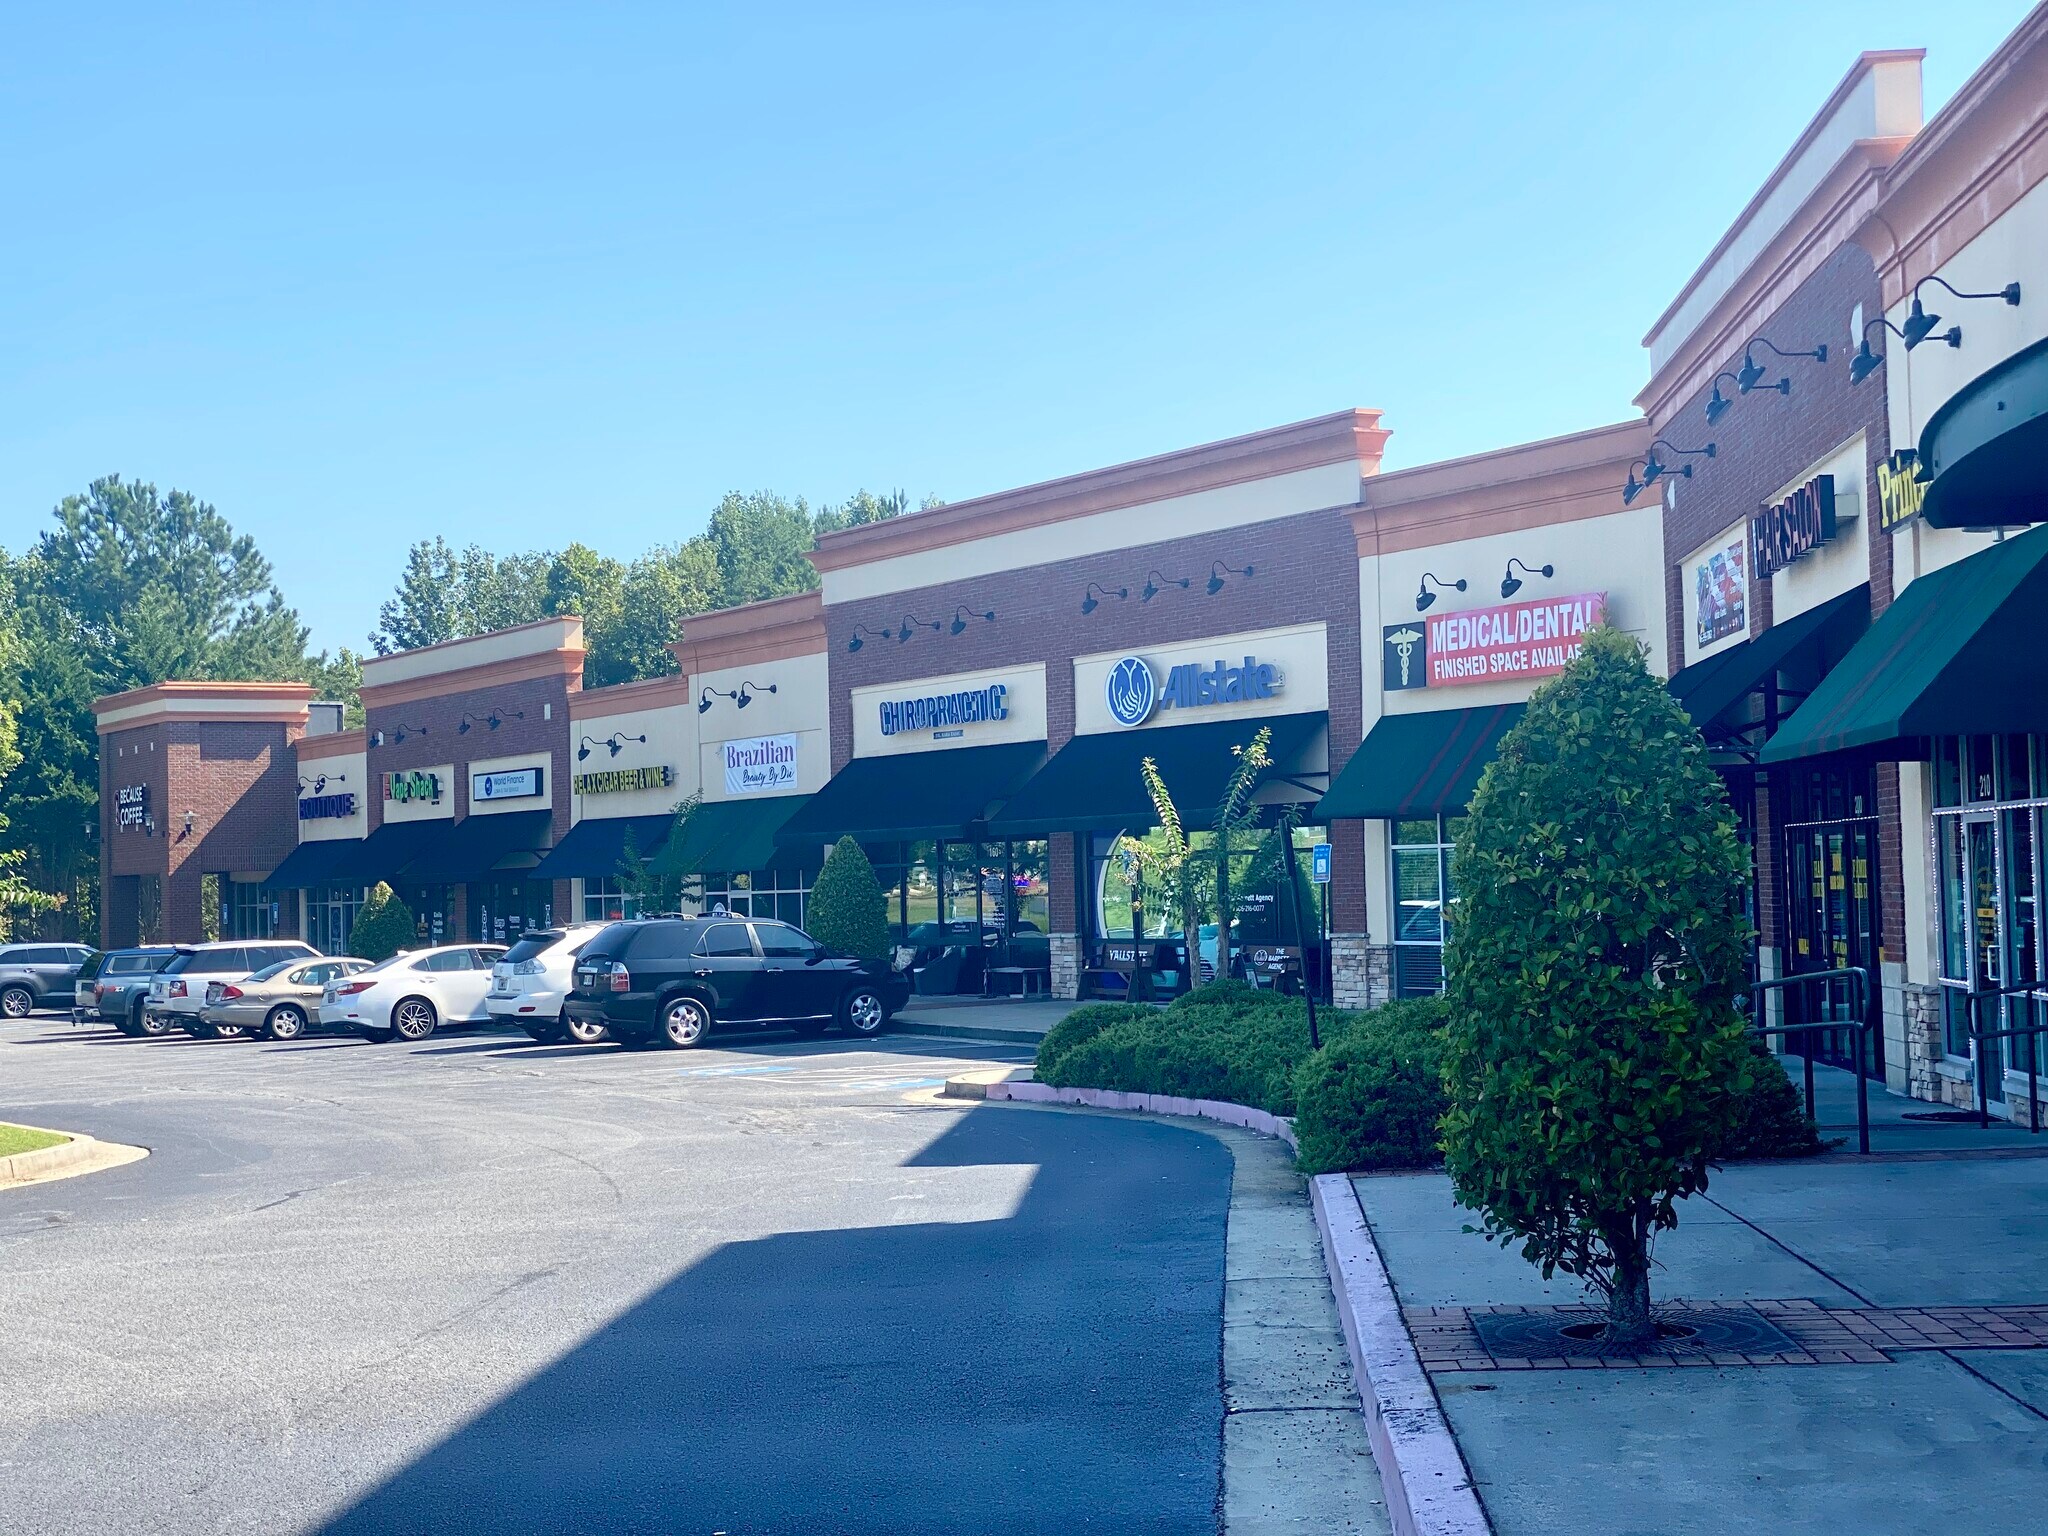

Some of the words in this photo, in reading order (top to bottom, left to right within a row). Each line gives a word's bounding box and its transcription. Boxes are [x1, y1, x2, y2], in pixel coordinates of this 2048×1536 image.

[1753, 504, 1784, 578] HAIR
[1784, 475, 1828, 561] SALON
[1432, 600, 1596, 653] MEDICAL/DENTAL
[1434, 654, 1487, 679] FINISHED
[1490, 650, 1528, 673] SPACE
[1160, 656, 1275, 709] Allstate
[880, 685, 1004, 735] CHIROPRACTIC
[727, 741, 794, 768] Brazilian
[390, 773, 409, 800] Vape
[410, 771, 433, 798] Shack
[494, 777, 506, 786] World
[507, 775, 525, 785] Finance
[573, 773, 597, 795] RELAX
[597, 771, 618, 793] CIGAR
[620, 768, 639, 791] BEER
[640, 768, 645, 789] &
[645, 766, 665, 788] WINE
[743, 769, 766, 787] Beauty
[769, 766, 779, 786] By
[1979, 774, 1990, 797] 210
[120, 786, 142, 804] BECAUSE
[299, 794, 352, 820] BOUTIQUE
[120, 806, 143, 825] COFFEE
[1255, 894, 1274, 903] Agency
